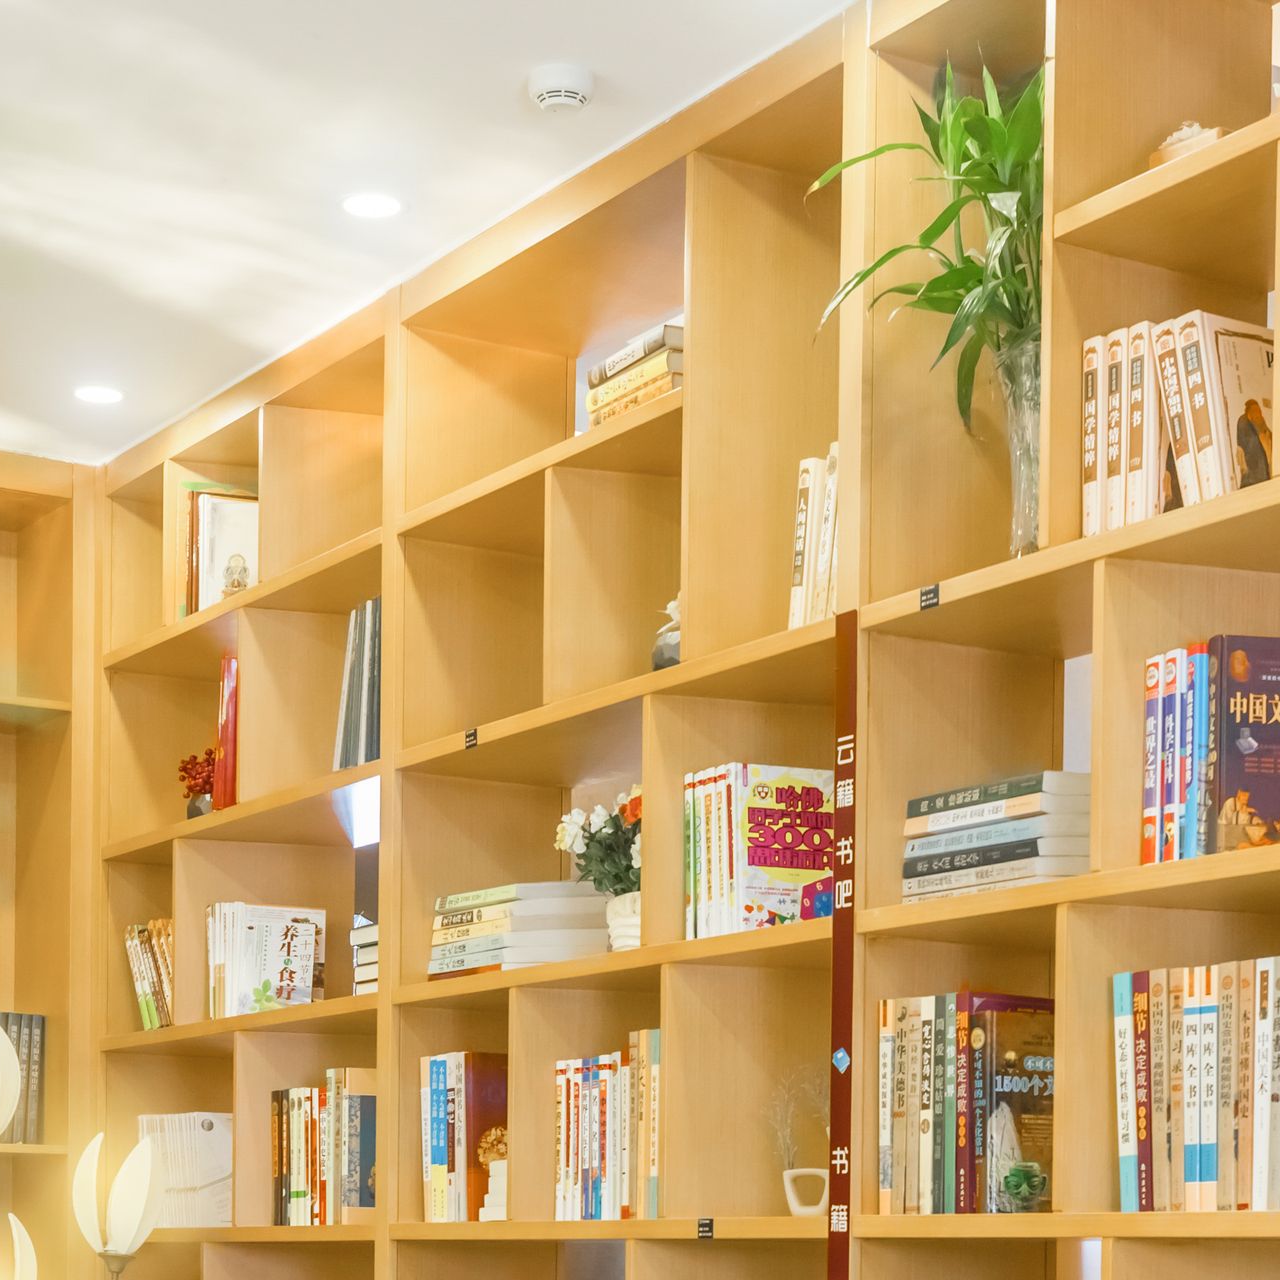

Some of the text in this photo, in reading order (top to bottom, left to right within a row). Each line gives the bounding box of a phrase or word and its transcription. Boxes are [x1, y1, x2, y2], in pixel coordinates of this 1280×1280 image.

[835, 733, 855, 909] 云籍书吧
[956, 1010, 968, 1113] 细节决定成败
[1133, 992, 1148, 1104] 细节决定成败
